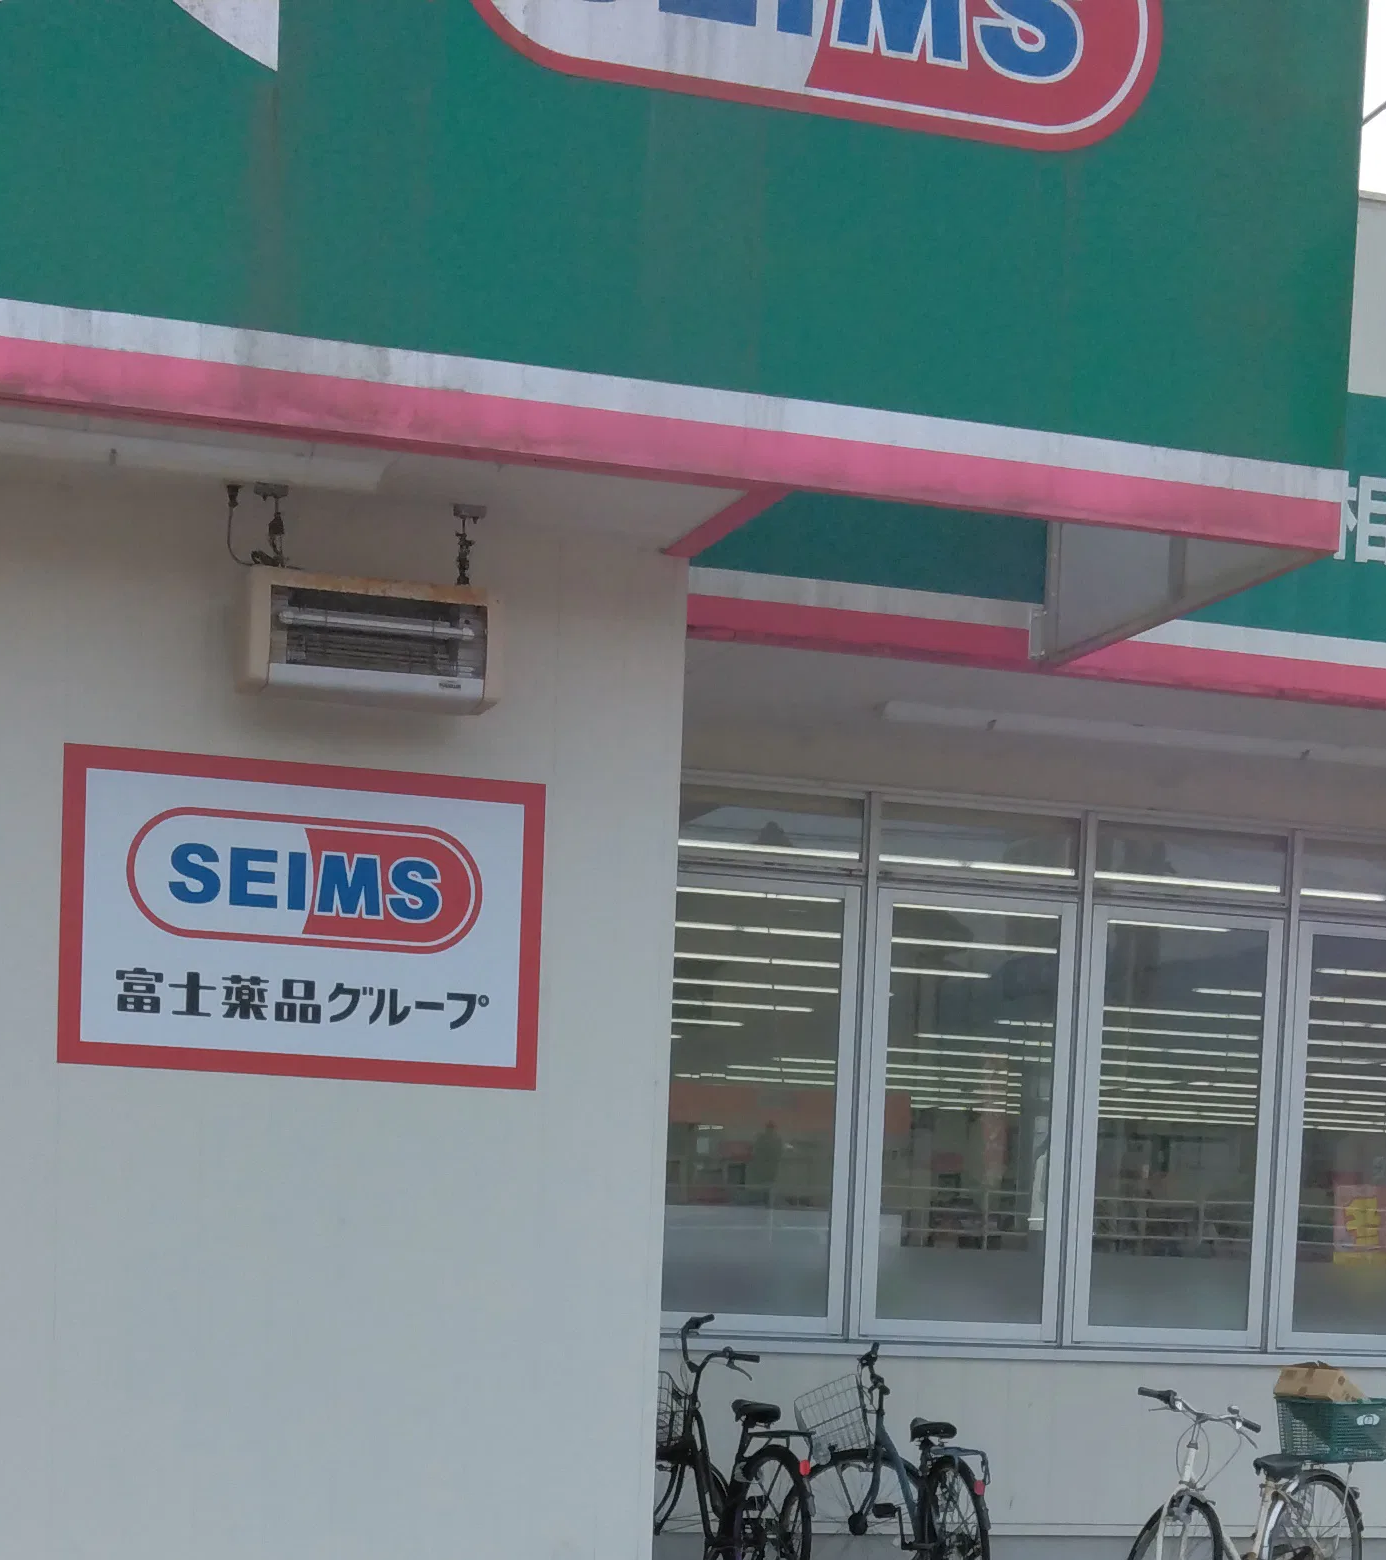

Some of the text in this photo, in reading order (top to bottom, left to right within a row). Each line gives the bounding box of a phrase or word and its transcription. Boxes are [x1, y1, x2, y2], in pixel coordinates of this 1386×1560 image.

[167, 842, 444, 924] SEIMS
[114, 966, 490, 1030] 富士薬品グループ
